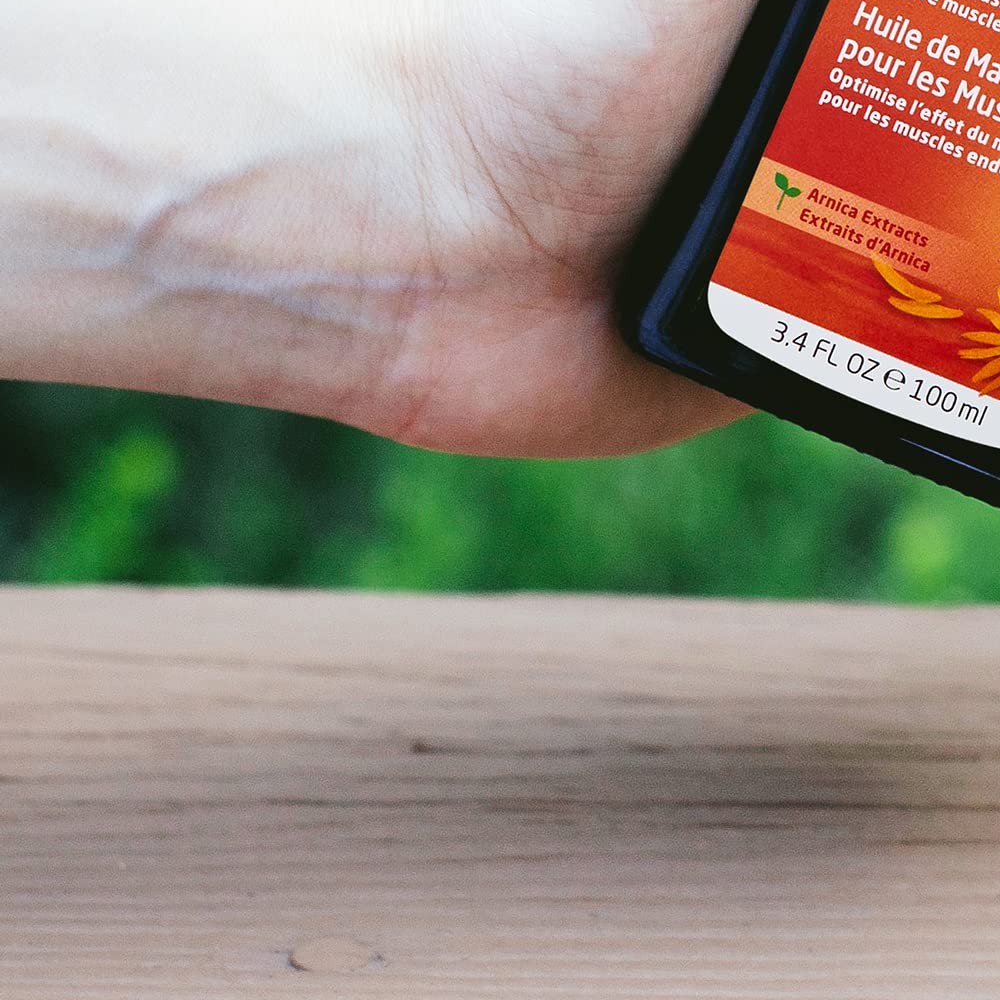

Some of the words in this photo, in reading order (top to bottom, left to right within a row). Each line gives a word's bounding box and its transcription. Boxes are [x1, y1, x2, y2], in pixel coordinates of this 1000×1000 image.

[853, 1, 922, 50] Huile
[926, 34, 960, 66] de
[836, 38, 906, 79] pour
[907, 60, 950, 98] les
[818, 90, 863, 116] pour
[863, 105, 891, 128] les
[892, 119, 964, 159] muscles
[829, 67, 908, 111] Optimise
[966, 125, 991, 145] du
[800, 208, 864, 244] Extraits
[807, 188, 858, 219] Arnica
[861, 210, 929, 247] Extracts
[770, 321, 809, 352] 3.4
[812, 339, 838, 367] FL
[847, 353, 881, 382] OZ
